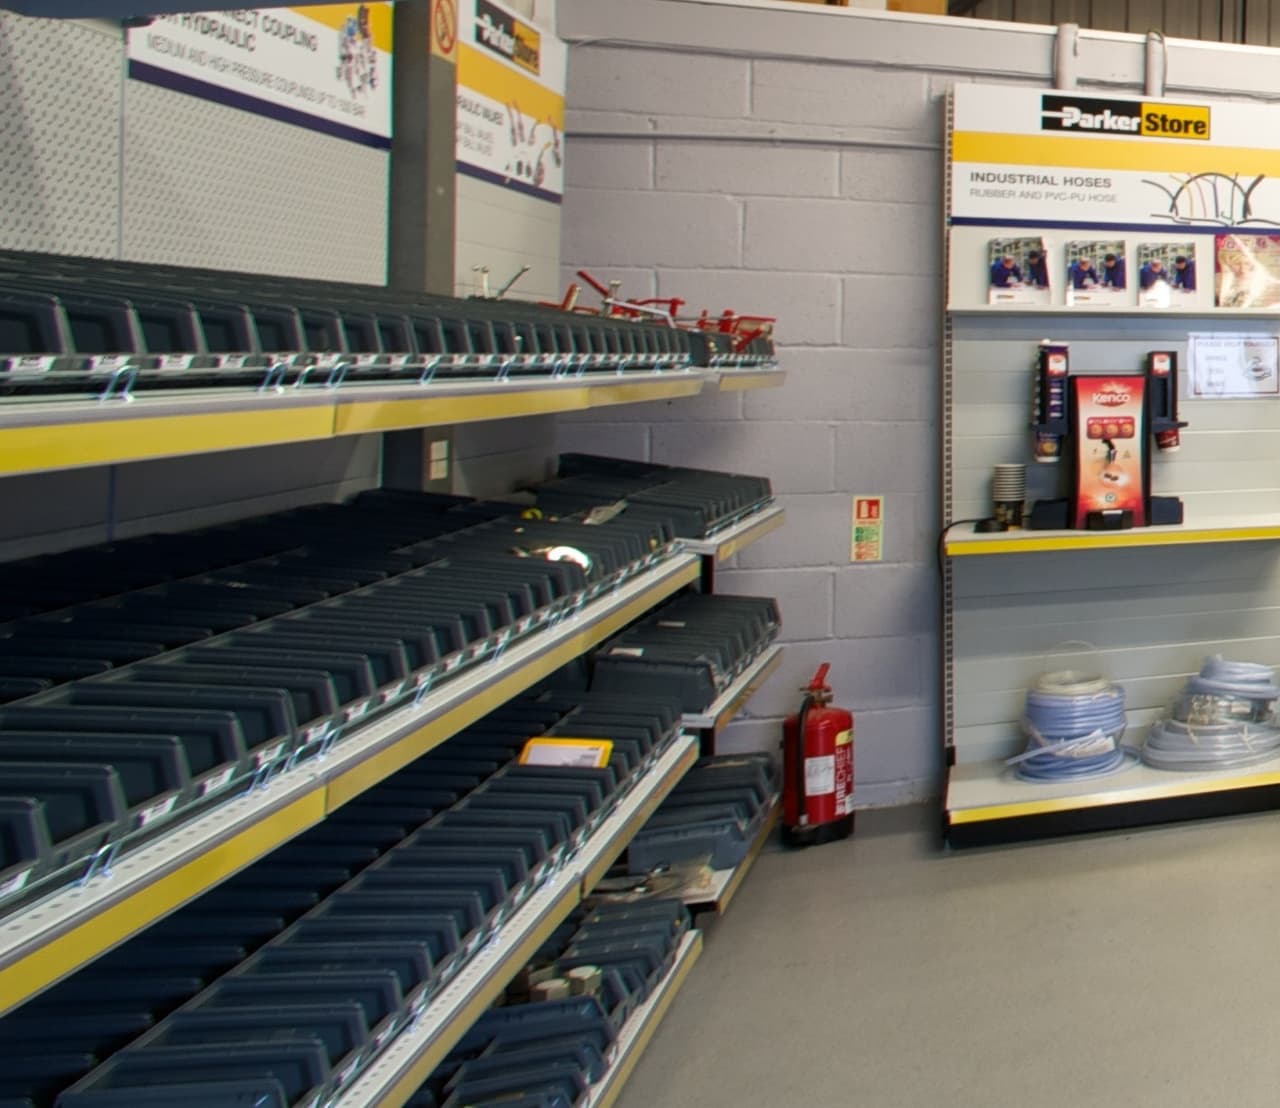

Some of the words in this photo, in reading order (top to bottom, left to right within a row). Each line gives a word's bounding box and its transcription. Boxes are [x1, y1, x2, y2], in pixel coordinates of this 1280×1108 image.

[182, 15, 255, 52] HYDRAULIC
[262, 15, 317, 52] COUPLING
[1145, 112, 1207, 135] Store
[970, 171, 1059, 186] INDUSTRIAL
[1063, 176, 1112, 188] HOSES
[970, 188, 1016, 199] RUBBER
[1019, 190, 1041, 200] AND
[1088, 193, 1117, 203] HOSE
[1092, 392, 1130, 403] Kenco
